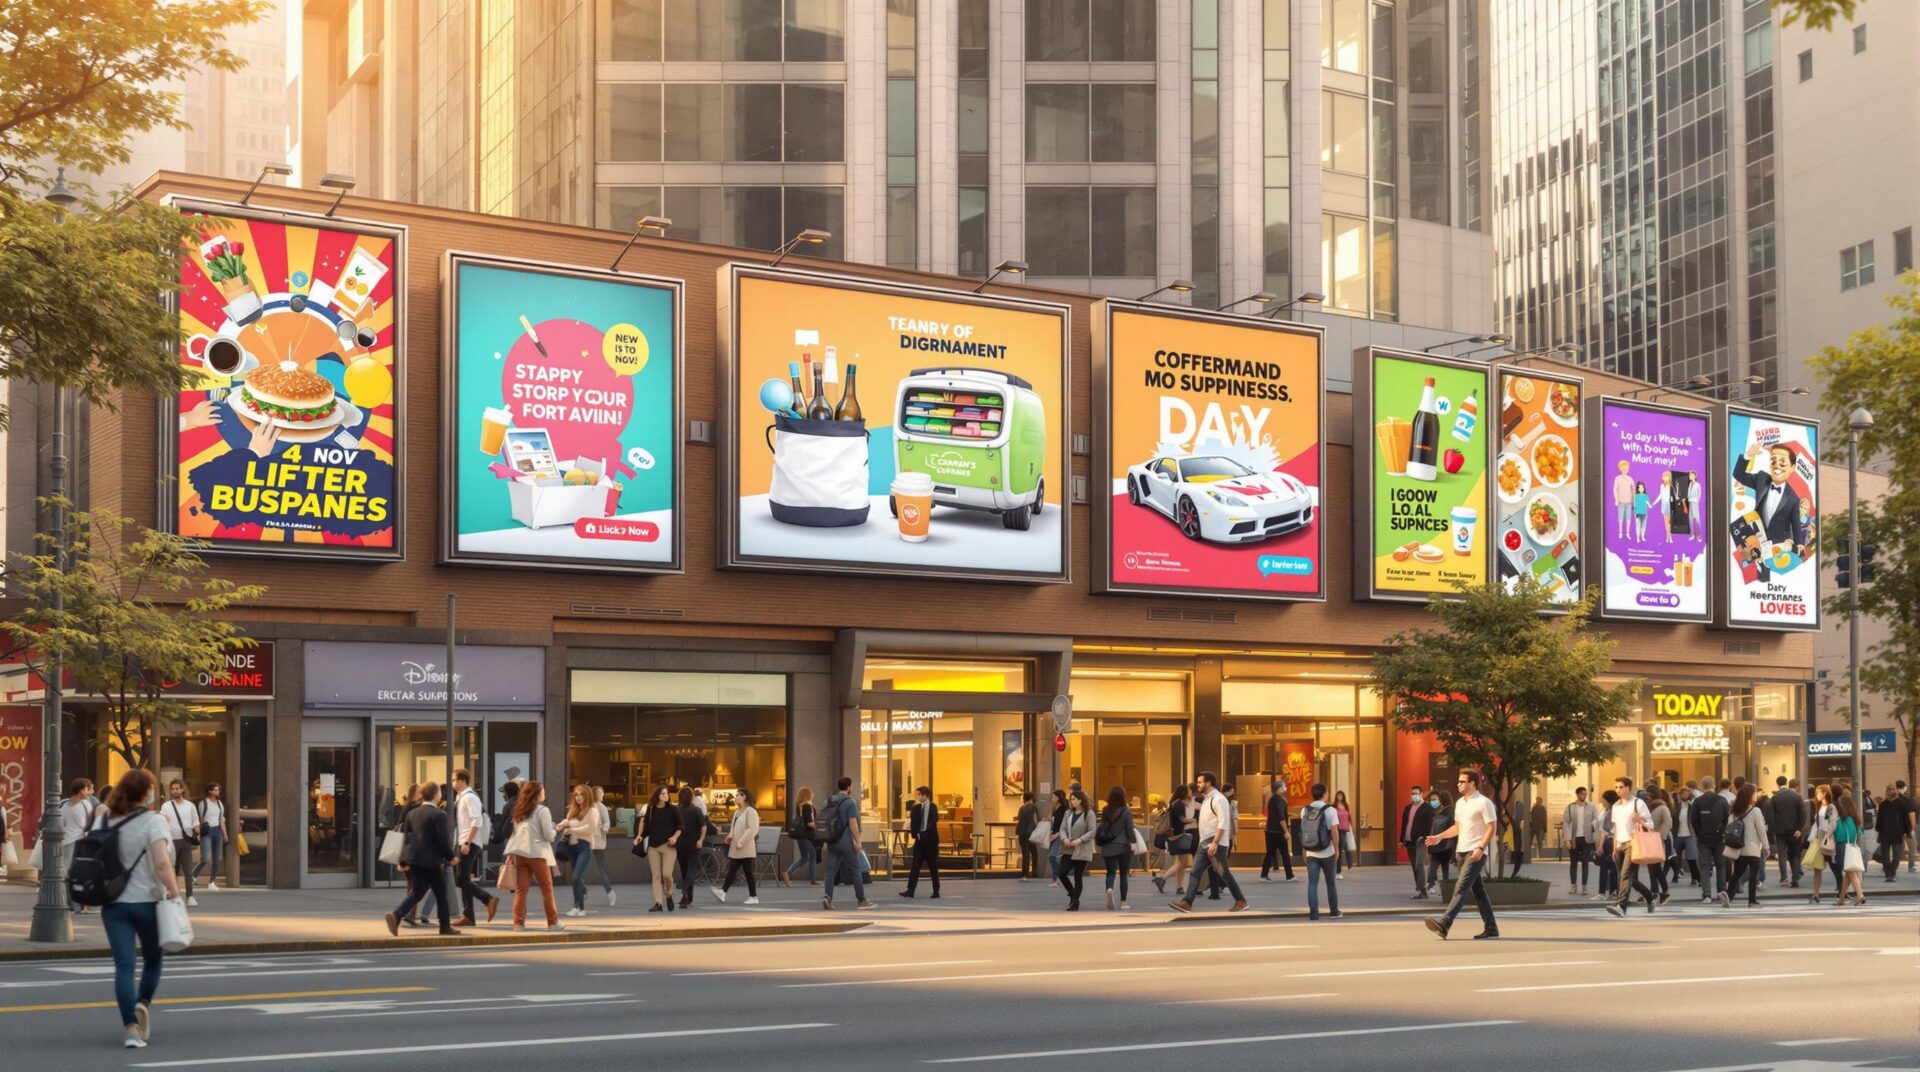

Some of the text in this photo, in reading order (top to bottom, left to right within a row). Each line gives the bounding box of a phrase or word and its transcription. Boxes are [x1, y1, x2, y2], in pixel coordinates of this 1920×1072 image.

[888, 316, 974, 338] TEANRY OF
[615, 334, 638, 344] NEW
[900, 335, 1007, 359] DIGRNAMENT
[624, 345, 637, 354] TO
[515, 363, 583, 384] STAPPY
[1154, 350, 1281, 380] COFFERMAND
[1145, 370, 1176, 389] MO
[512, 383, 569, 402] STORP
[522, 403, 567, 420] FORT
[1159, 395, 1272, 450] DAY
[282, 444, 359, 465] 4 NOV
[245, 461, 368, 494] LIFTER
[211, 485, 388, 522] BUSPANES
[1396, 489, 1437, 503] GOOW
[628, 526, 649, 536] Now
[1390, 517, 1449, 532] SUPNCES
[1760, 602, 1806, 616] LOVEES
[1653, 694, 1722, 716] TODAY
[1652, 723, 1724, 737] CURMENTS
